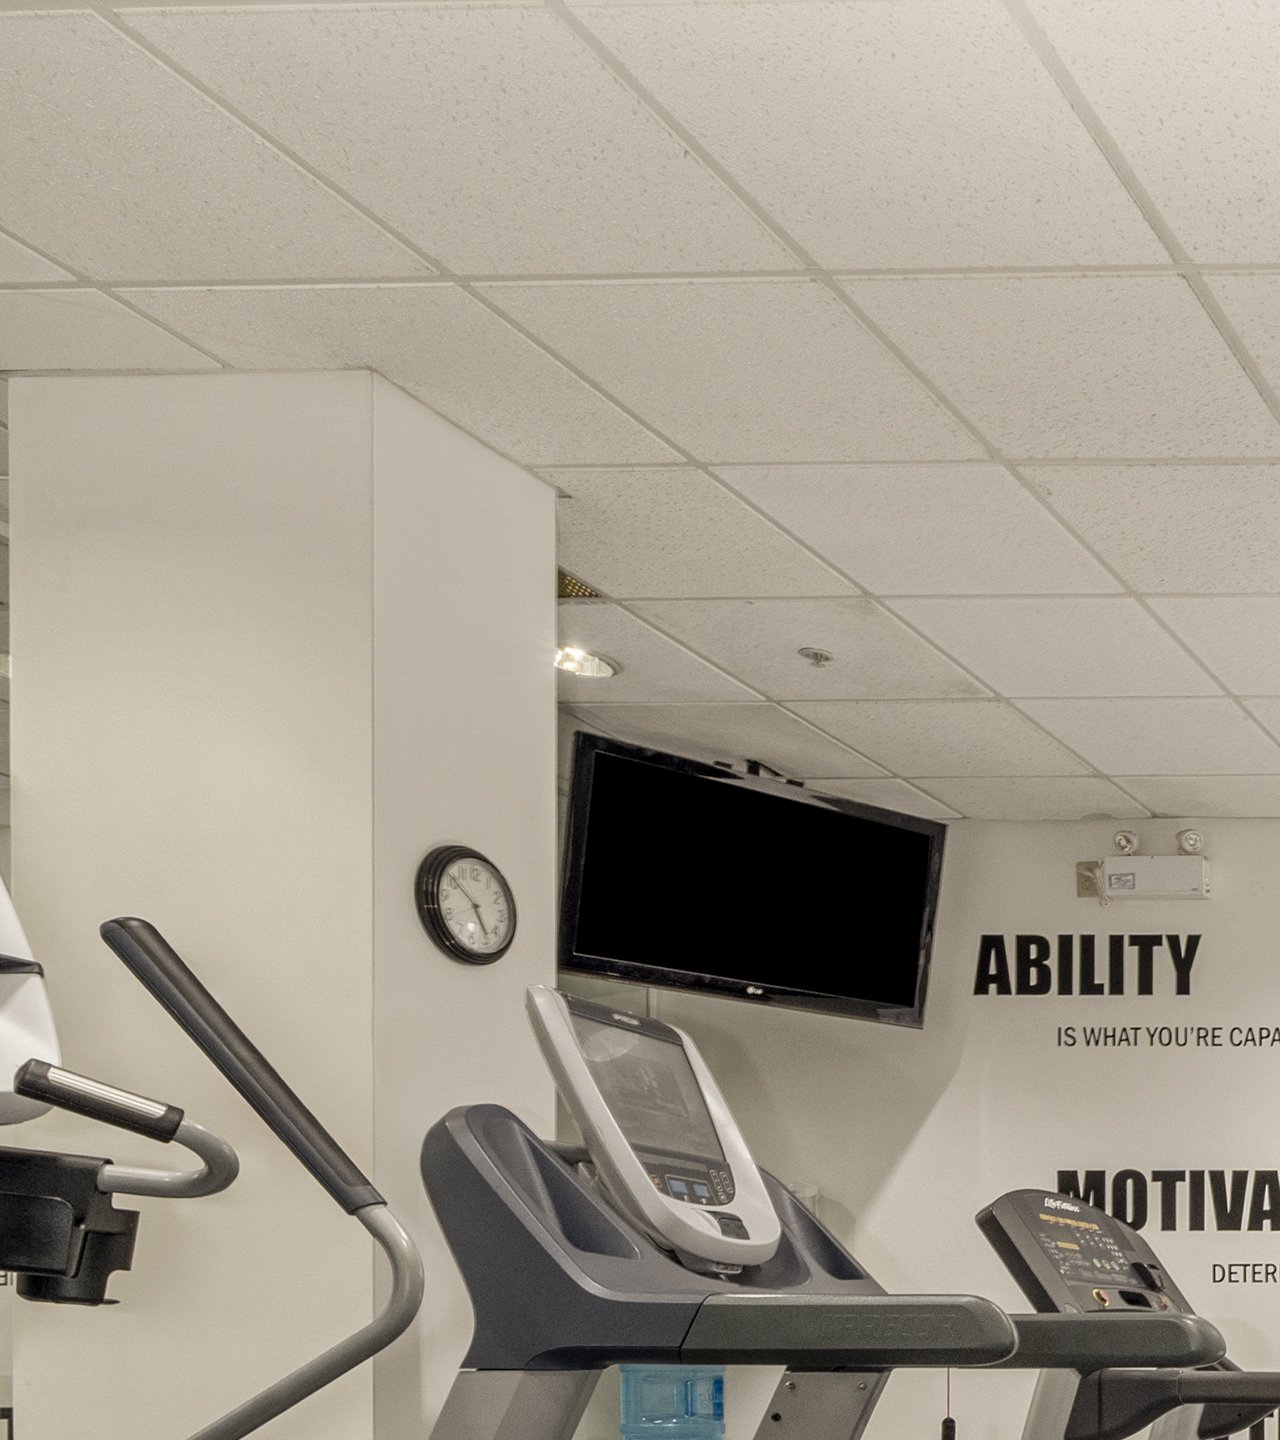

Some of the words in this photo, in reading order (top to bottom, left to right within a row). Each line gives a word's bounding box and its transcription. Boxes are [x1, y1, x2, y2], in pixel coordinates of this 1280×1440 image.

[973, 934, 1201, 995] ABILITY
[1058, 1027, 1076, 1047] IS
[1083, 1027, 1142, 1047] WHAT
[1146, 1027, 1224, 1047] YOU'RE
